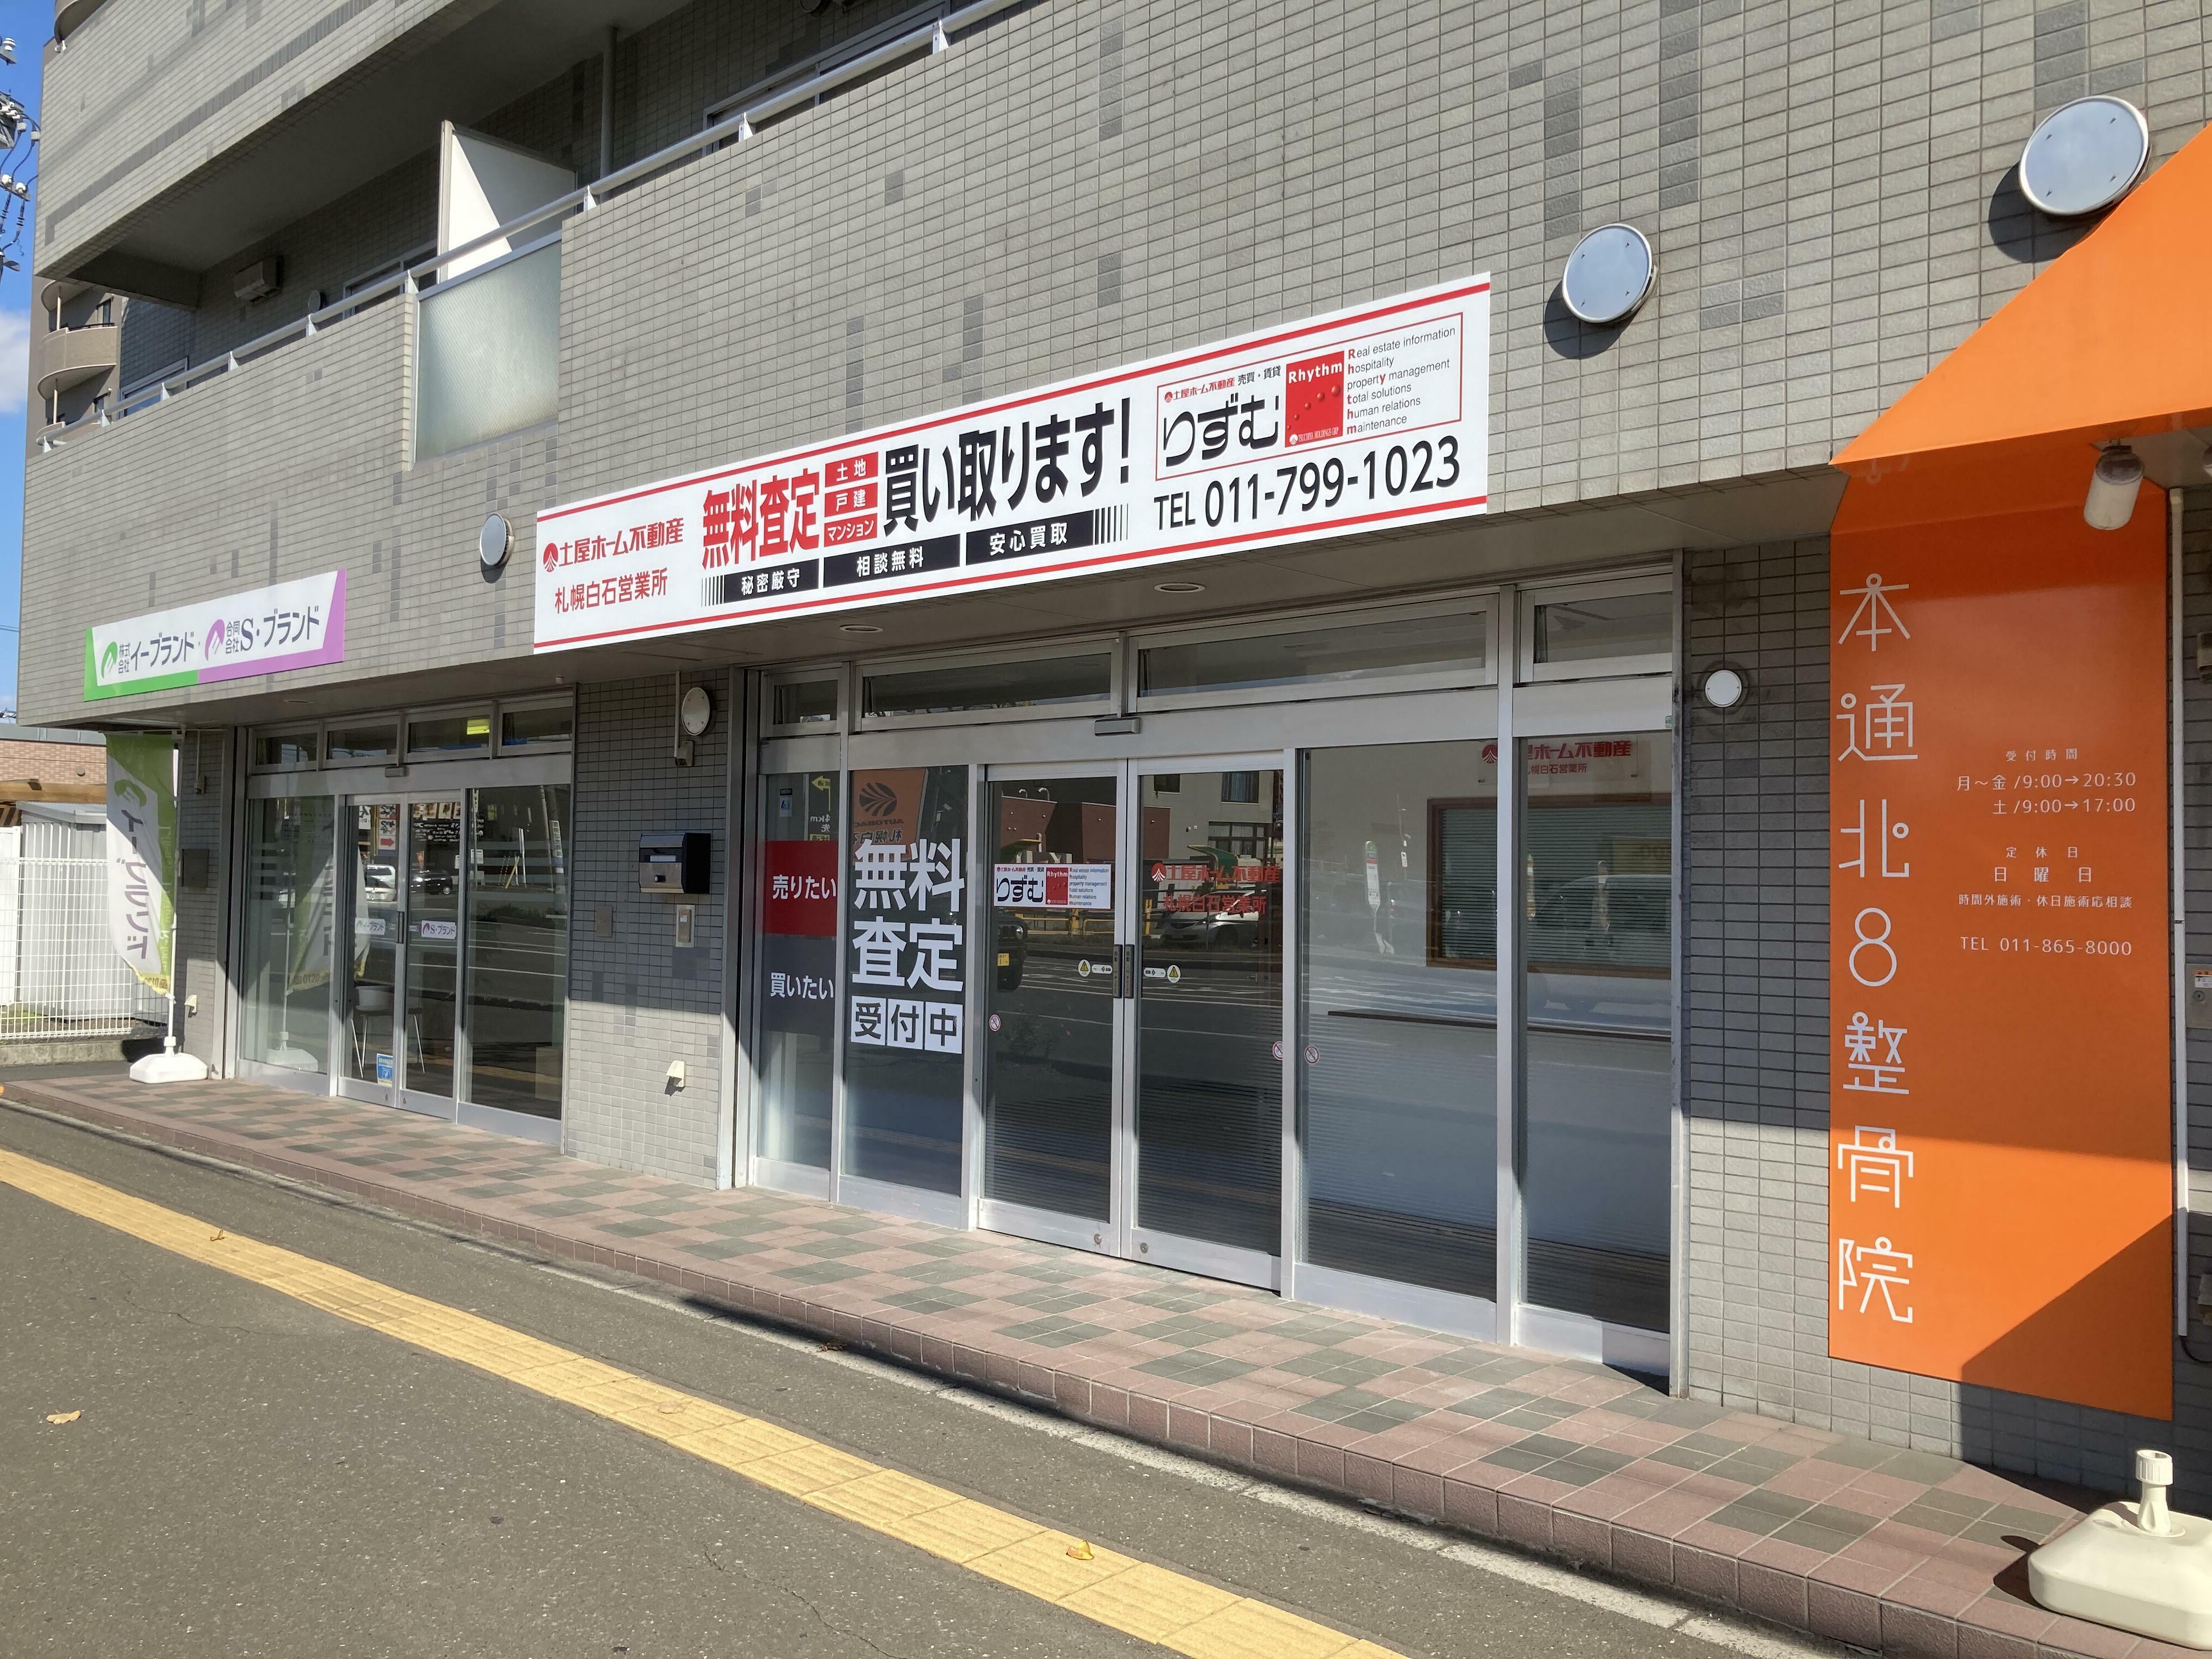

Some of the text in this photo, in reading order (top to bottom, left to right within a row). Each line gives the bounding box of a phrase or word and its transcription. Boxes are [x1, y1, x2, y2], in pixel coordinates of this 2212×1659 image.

[1348, 326, 1456, 360] Real estate information
[1288, 360, 1343, 385] Rhythm
[1347, 356, 1394, 375] hospitality
[1347, 359, 1450, 391] property management
[1173, 365, 1281, 401] 土屋ホーム不動産 売買・賃貸
[1347, 382, 1412, 405] total solutions
[1347, 396, 1421, 420] human relations
[1163, 393, 1280, 467] りずむ
[1347, 414, 1408, 435] maintenance
[836, 458, 867, 482] 土地
[1154, 435, 1461, 531] TEL 011-799-1023
[836, 488, 867, 512] 戸建
[702, 468, 820, 571] 無料査定
[827, 520, 874, 541] マンション
[558, 517, 684, 568] 土屋ホーム不動産
[741, 522, 1068, 596] 秘密厳守 相談無料 安心買取
[555, 567, 668, 614] 札幌白石営業所
[226, 620, 240, 637] 合同
[240, 605, 320, 651] S・ブランド
[119, 642, 130, 658] 株式
[130, 631, 195, 672] イーブランド
[225, 637, 240, 654] 会社
[118, 658, 129, 674] 会社
[2006, 748, 2078, 762] 受付時間
[1527, 763, 1587, 775] 幌白石営業所
[1993, 799, 2007, 815] 土
[2006, 847, 2078, 859] 定休日
[854, 837, 965, 912] 無料
[1047, 870, 1068, 878] Rhythm
[1165, 864, 1281, 883] 土屋ホーム不動産
[1994, 866, 2092, 883] 日曜日
[772, 875, 837, 900] 売りたい
[996, 874, 1044, 902] りずむ
[1163, 895, 1267, 915] 札幌白石営業所
[852, 916, 964, 992] 査定
[1836, 573, 1918, 1323] 本通北8整骨院
[1960, 937, 2132, 956] TEL 011-865-8000
[770, 972, 834, 1000] 買いたい
[854, 1002, 958, 1047] 受付中
